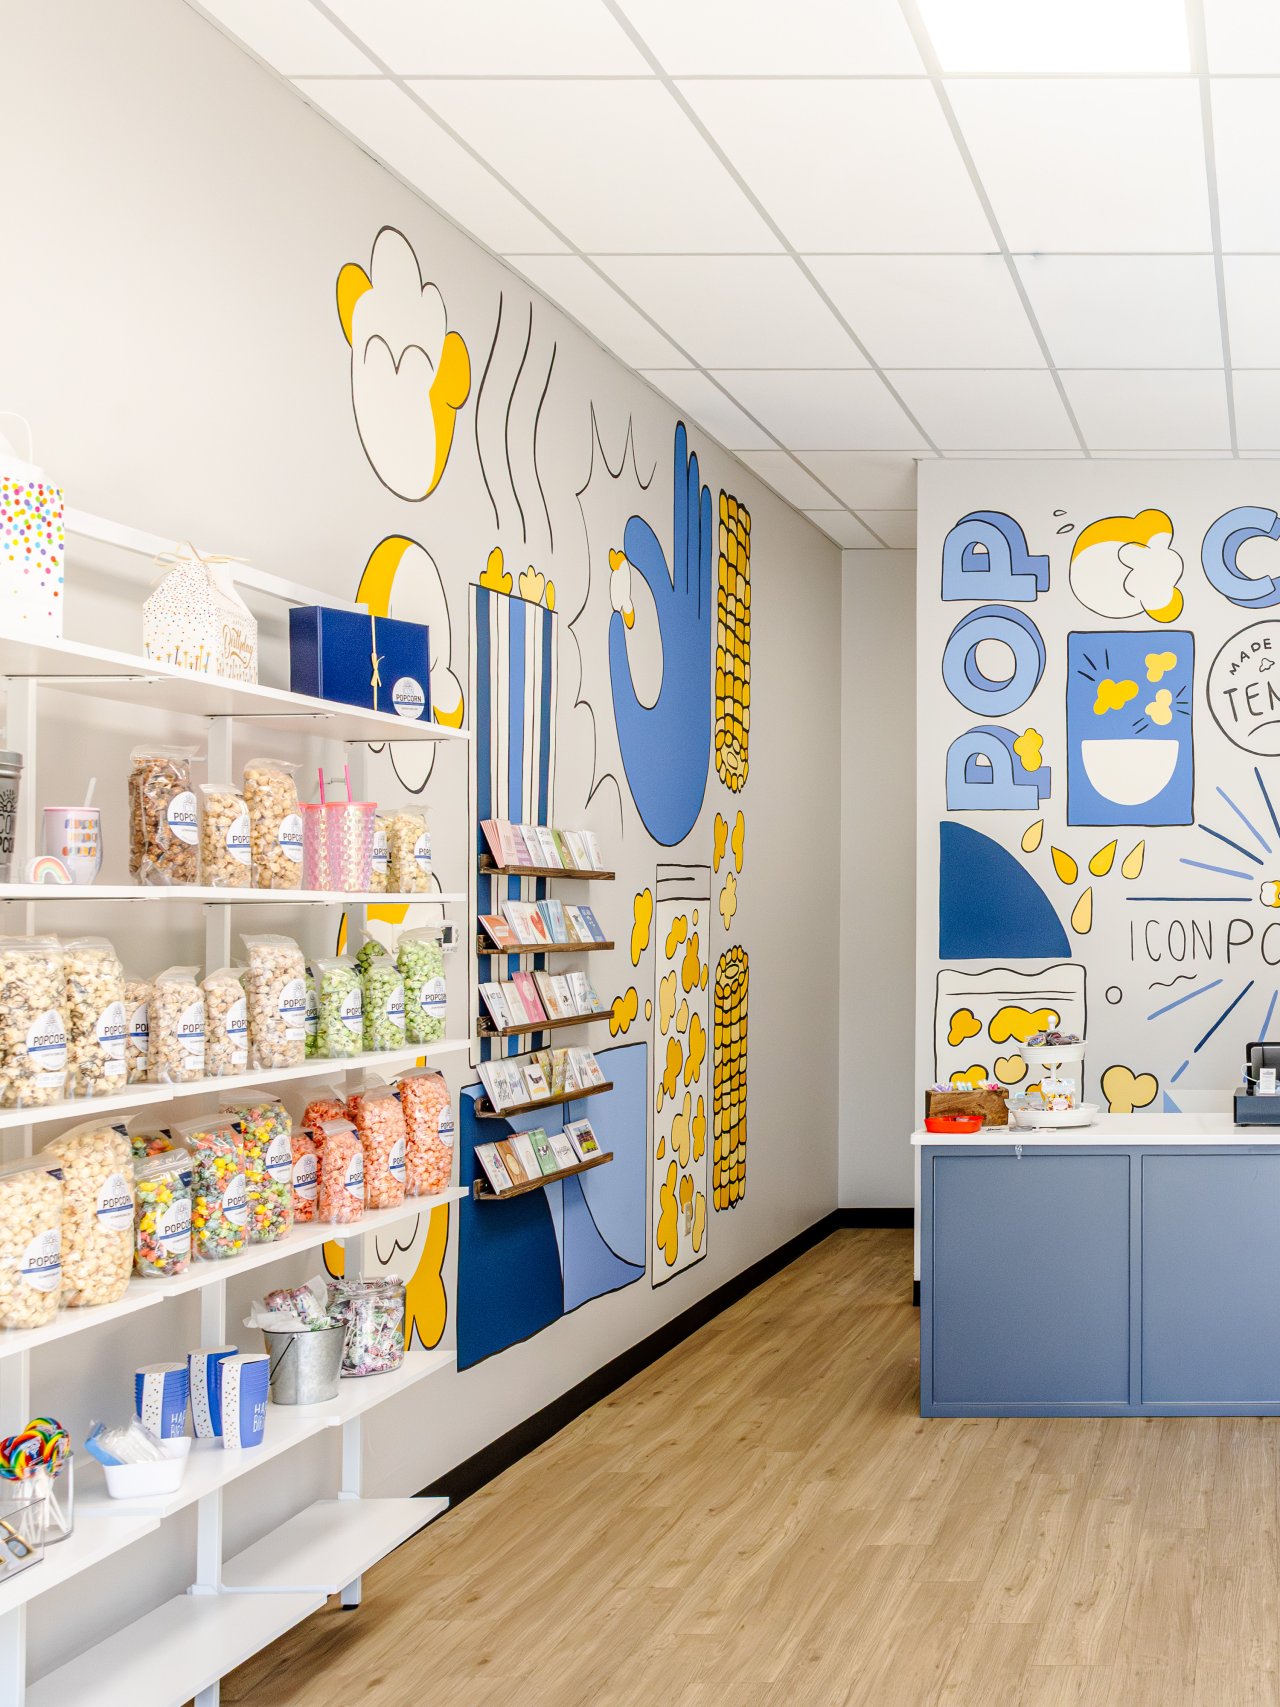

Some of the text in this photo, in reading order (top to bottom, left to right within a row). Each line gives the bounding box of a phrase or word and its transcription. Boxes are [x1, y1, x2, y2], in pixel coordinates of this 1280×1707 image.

[942, 510, 1050, 811] POP
[1229, 638, 1272, 675] MADE
[396, 694, 422, 703] POPCORN
[33, 1033, 66, 1047] POPCOR
